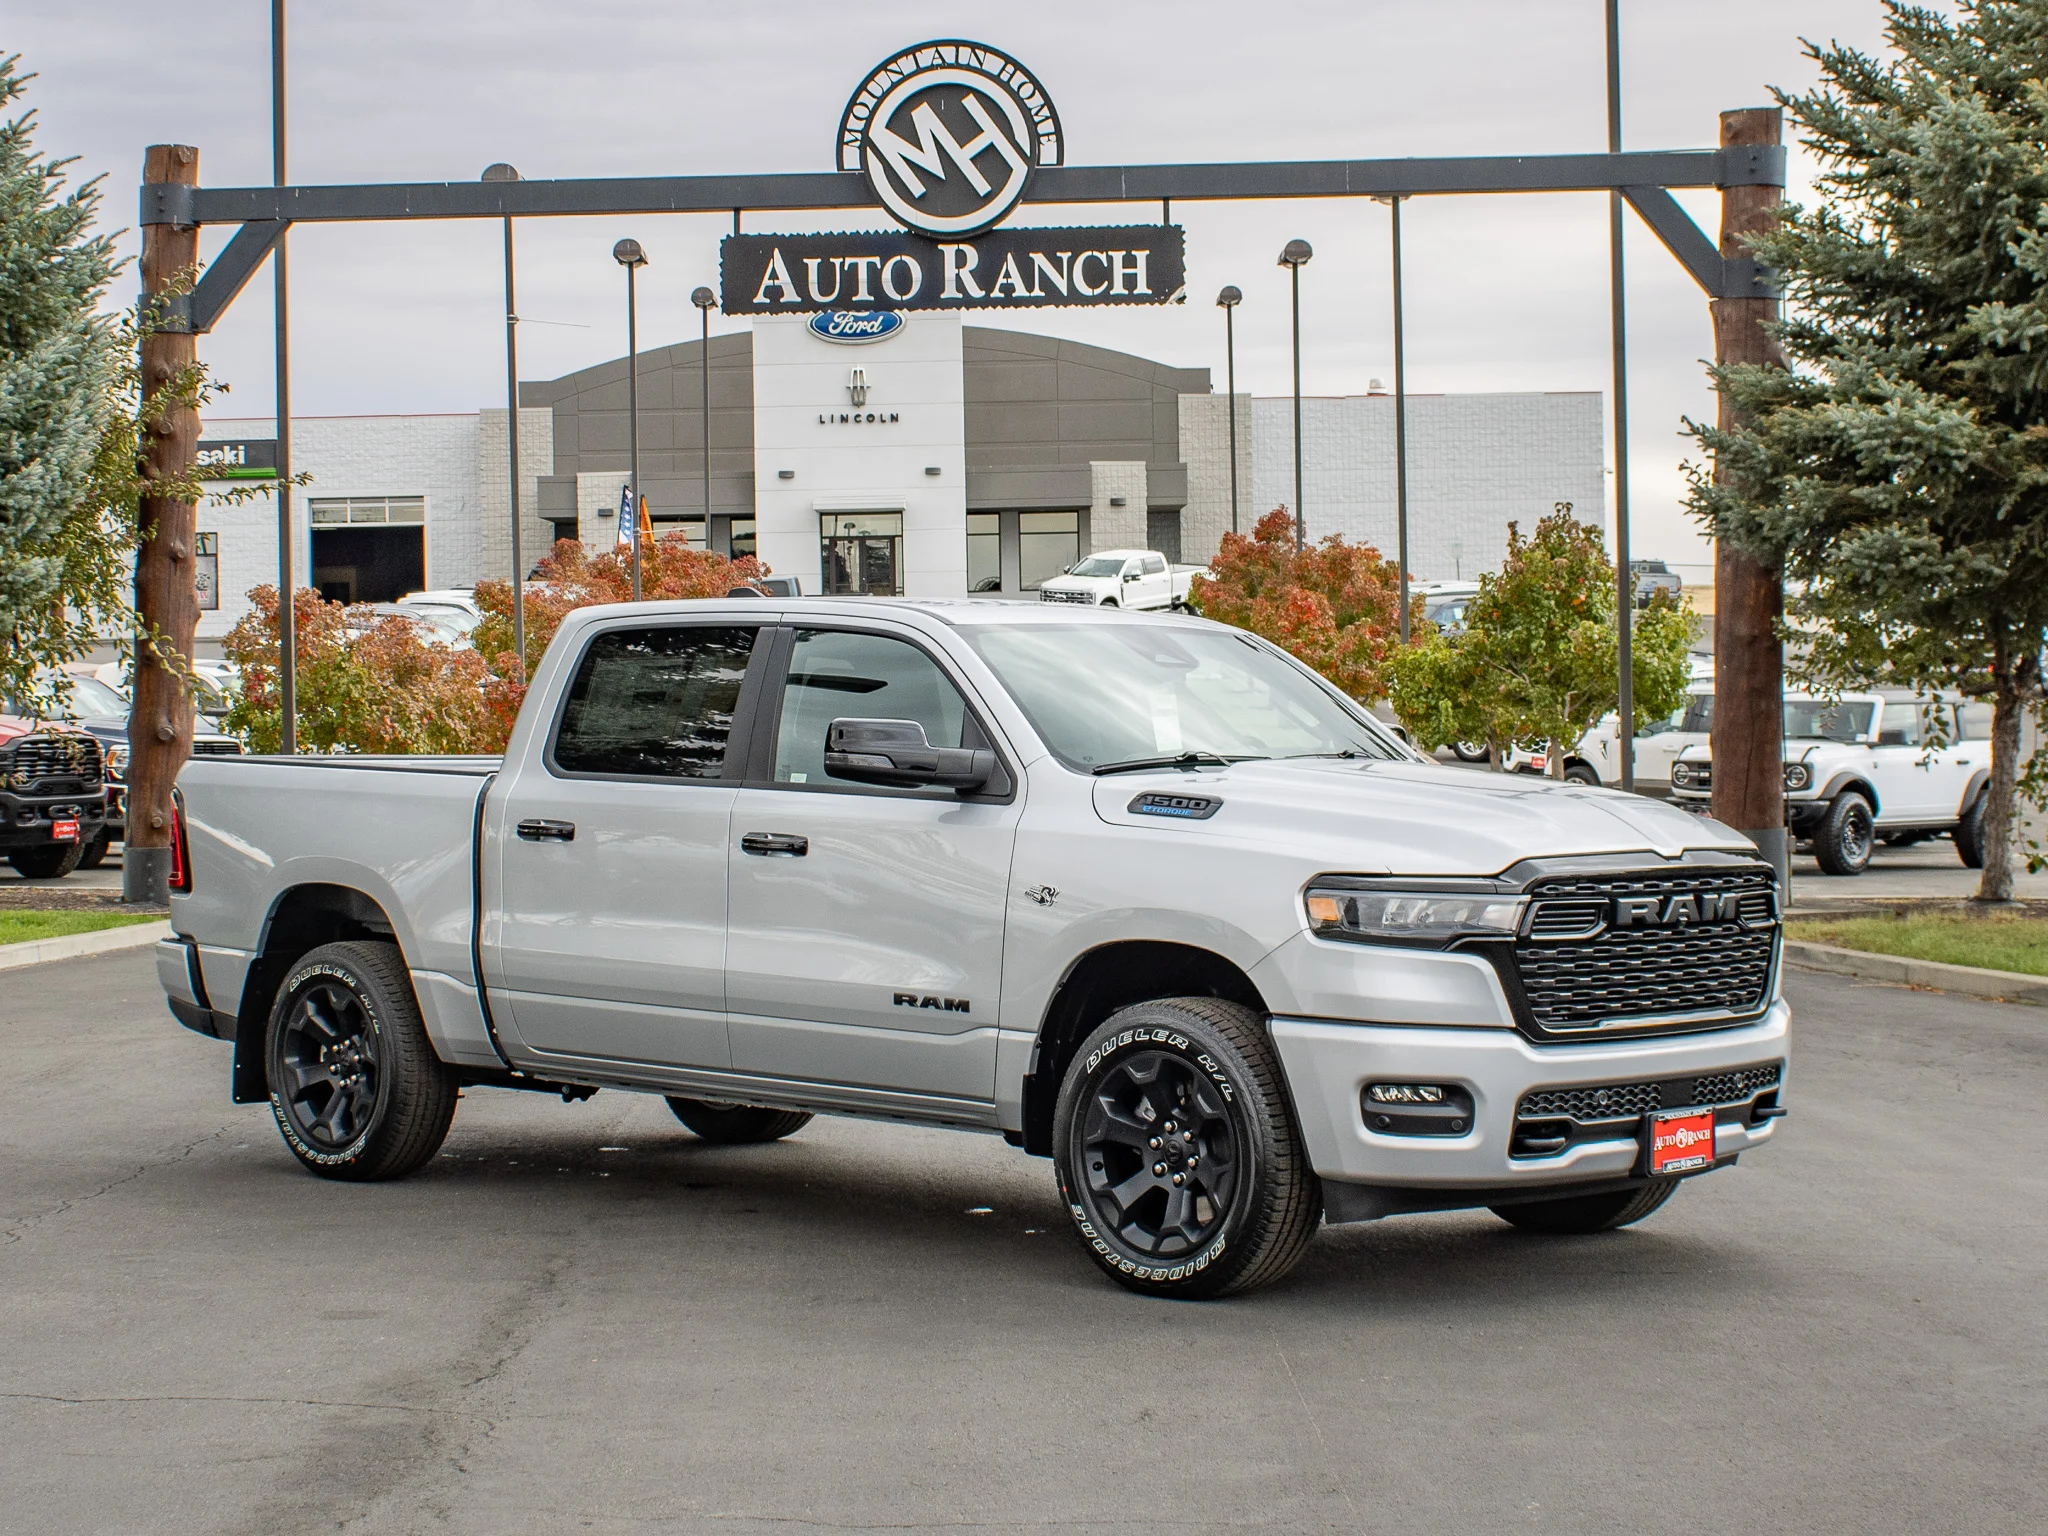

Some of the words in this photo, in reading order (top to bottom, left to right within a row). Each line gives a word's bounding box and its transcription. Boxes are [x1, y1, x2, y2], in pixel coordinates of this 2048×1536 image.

[844, 46, 987, 148] MOUNTAIN
[998, 62, 1058, 147] HOME
[753, 247, 923, 304] AUTO
[937, 243, 1153, 299] RANCH
[828, 311, 883, 334] Ford
[819, 413, 899, 424] LINCOLN
[195, 445, 246, 467] saki
[1140, 795, 1206, 810] 1500
[1617, 892, 1736, 925] RAM
[289, 964, 357, 992] DUELER
[893, 992, 970, 1013] RAM
[1087, 1029, 1189, 1074] DUELER
[1653, 1135, 1676, 1151] AUTO
[1687, 1128, 1711, 1146] RANCH
[1071, 1203, 1226, 1281] BRIDGESTONE
